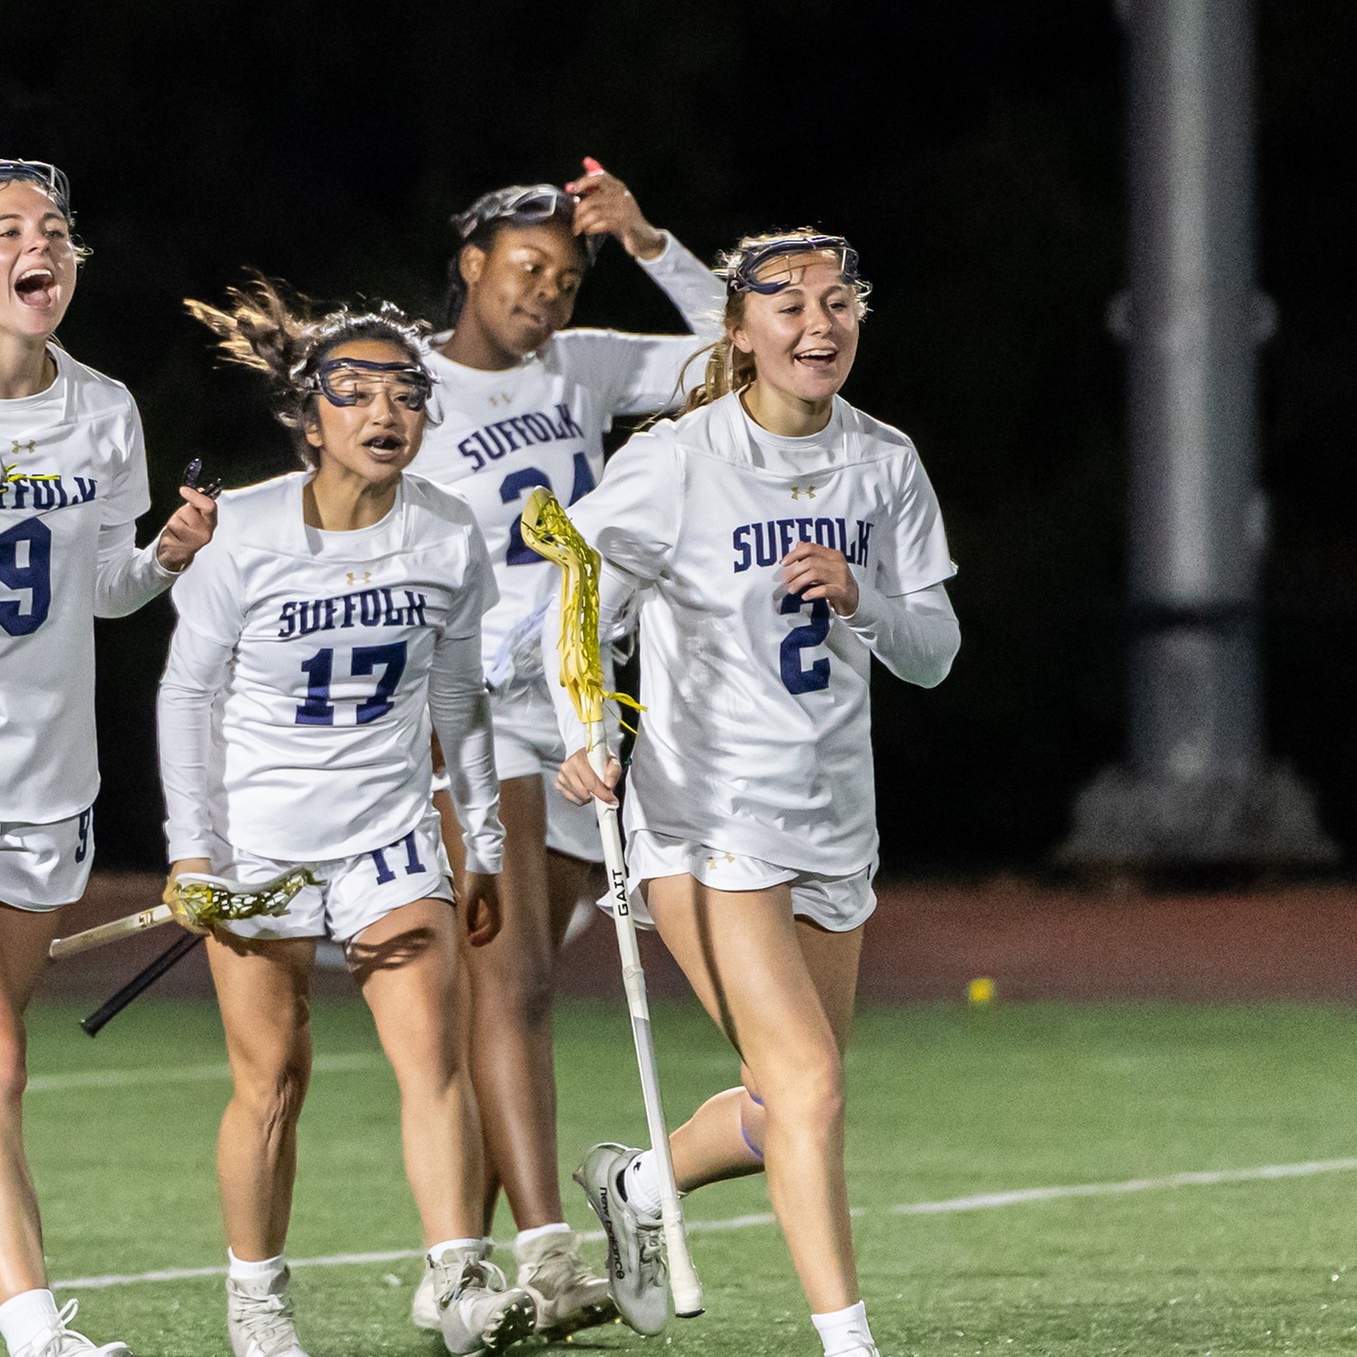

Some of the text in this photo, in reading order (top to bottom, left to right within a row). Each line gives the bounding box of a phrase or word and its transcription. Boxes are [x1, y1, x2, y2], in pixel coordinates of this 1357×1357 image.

[458, 404, 584, 472] SUFFOLK
[278, 588, 427, 638] SUFFOLK
[780, 584, 831, 696] 2
[295, 640, 408, 725] 17
[612, 869, 629, 917] GAIT
